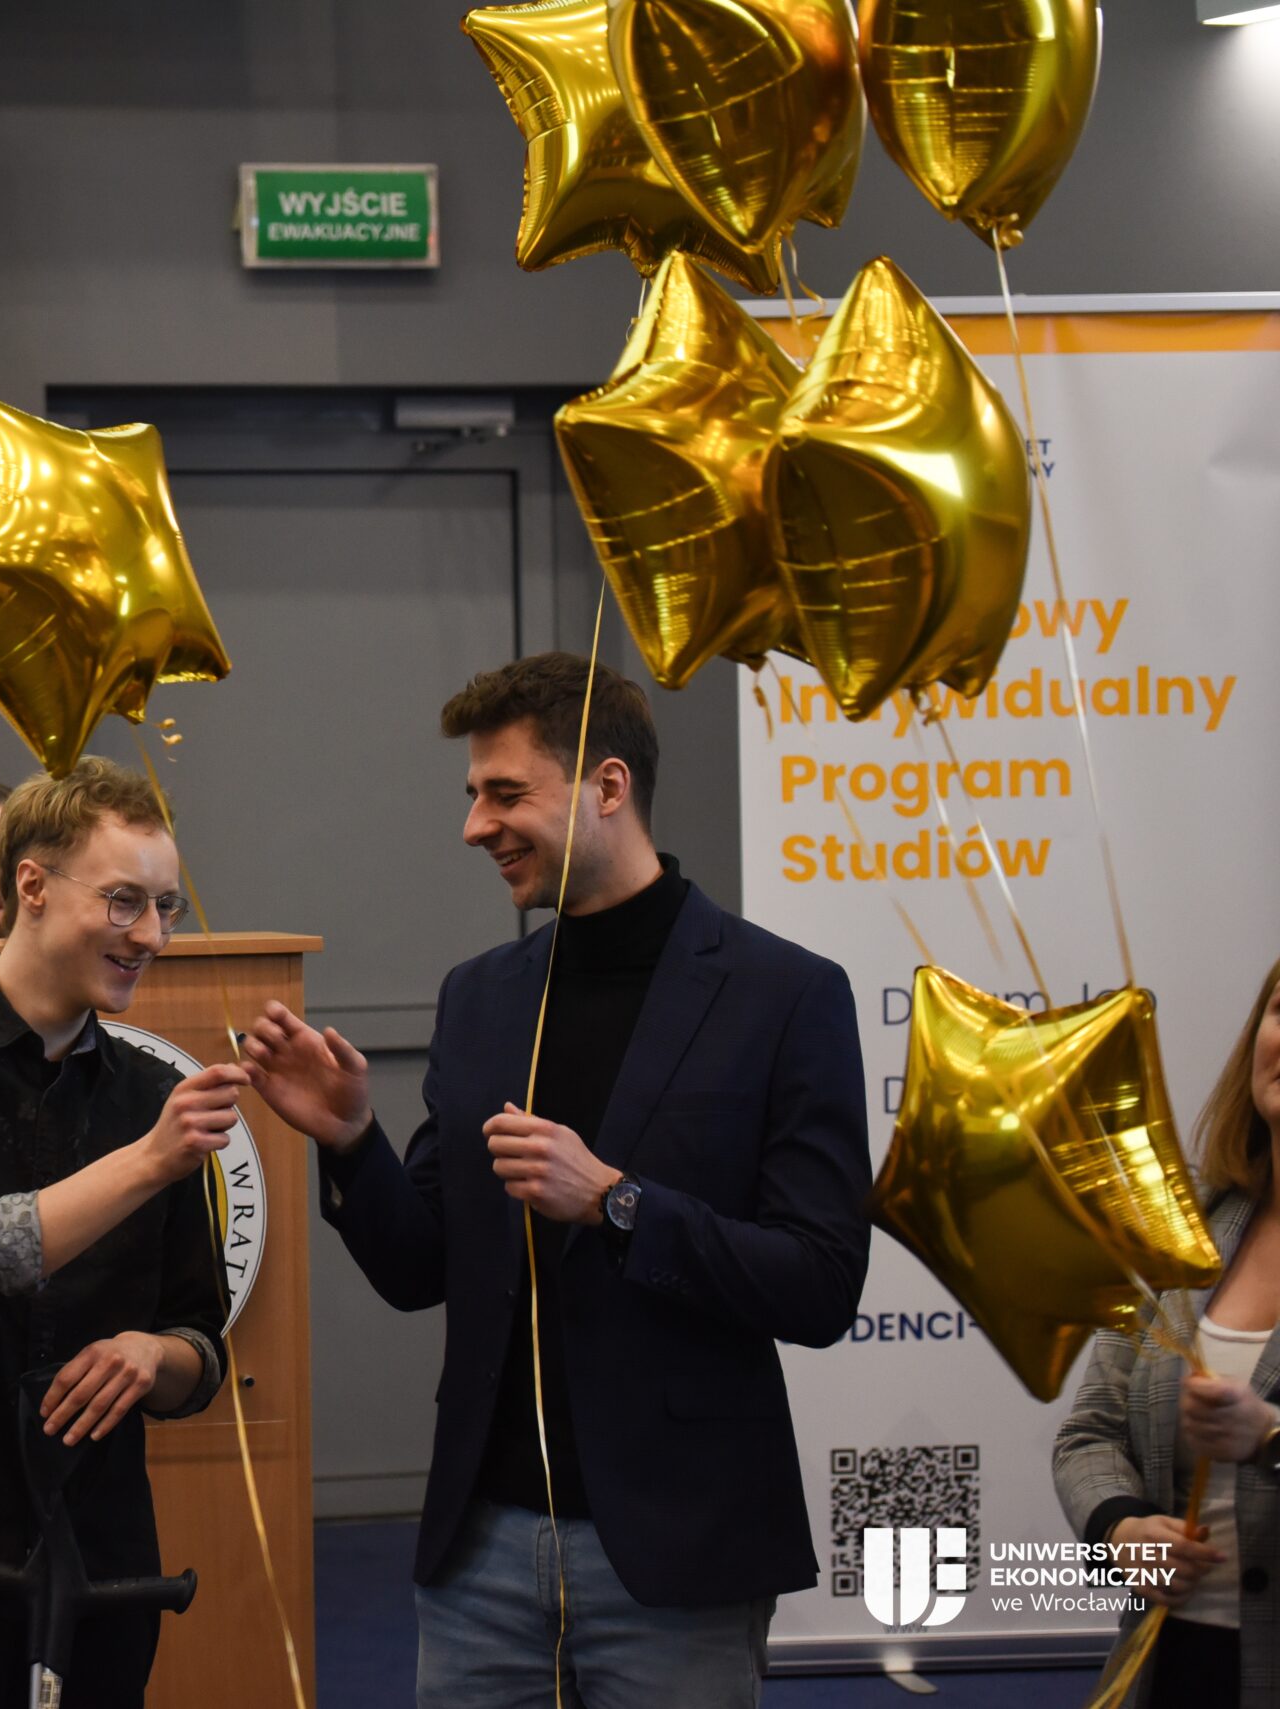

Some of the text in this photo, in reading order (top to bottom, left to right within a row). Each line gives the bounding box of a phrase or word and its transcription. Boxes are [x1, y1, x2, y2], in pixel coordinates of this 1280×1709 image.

[277, 186, 409, 218] WYJŚCIE
[267, 222, 421, 242] EWAKUACYJNE
[780, 666, 1237, 738] Inywidualny
[781, 755, 1071, 818] Program
[781, 830, 1051, 883] Studiów
